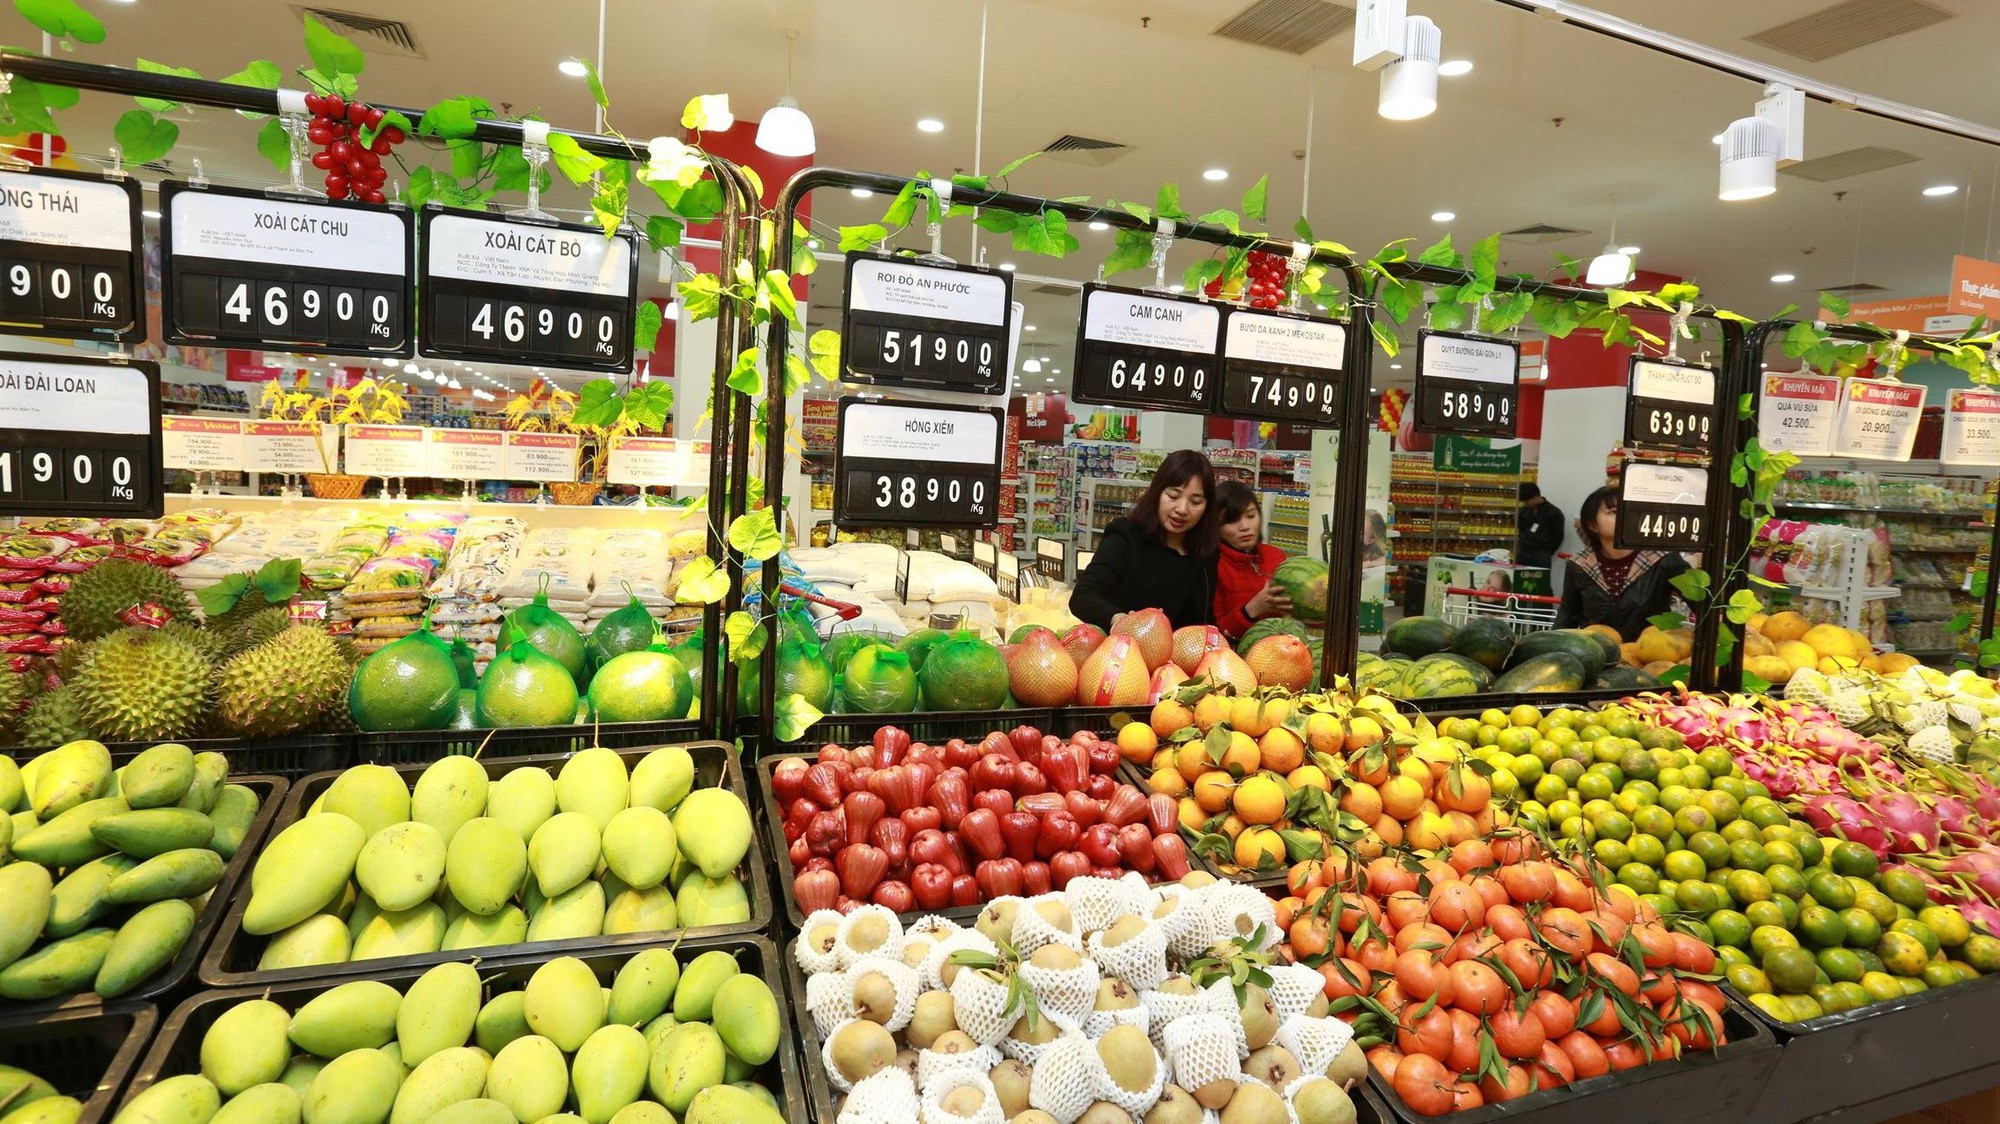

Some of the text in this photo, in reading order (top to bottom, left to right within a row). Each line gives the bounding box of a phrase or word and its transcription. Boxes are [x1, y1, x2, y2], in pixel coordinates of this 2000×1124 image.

[39, 191, 78, 213] THÁI
[254, 211, 349, 237] XOÀI CÁT CHU
[484, 230, 521, 251] XOÀI
[525, 234, 556, 255] CÁT
[877, 272, 971, 295] ROI ĐỎ AN PHƯỚC
[93, 302, 115, 317] /Kg
[1130, 304, 1183, 323] CAM CANH
[370, 323, 390, 337] /Kg
[1257, 325, 1267, 333] DA
[1268, 326, 1286, 336] XANH
[1286, 329, 1291, 337] 2
[596, 341, 613, 356] /Kg
[977, 365, 991, 377] /Kg
[25, 372, 50, 391] ĐÀI
[55, 378, 96, 394] LOAN
[1783, 381, 1826, 395] KHUYẾN MÃI
[1190, 390, 1202, 401] /Kg
[1868, 387, 1911, 401] KHUYẾN MÃI
[1321, 404, 1332, 415] /Kg
[1782, 417, 1810, 429] 42.500
[1862, 421, 1891, 433] 20.900
[112, 486, 134, 500] /Kg
[970, 503, 984, 515] /Kg
